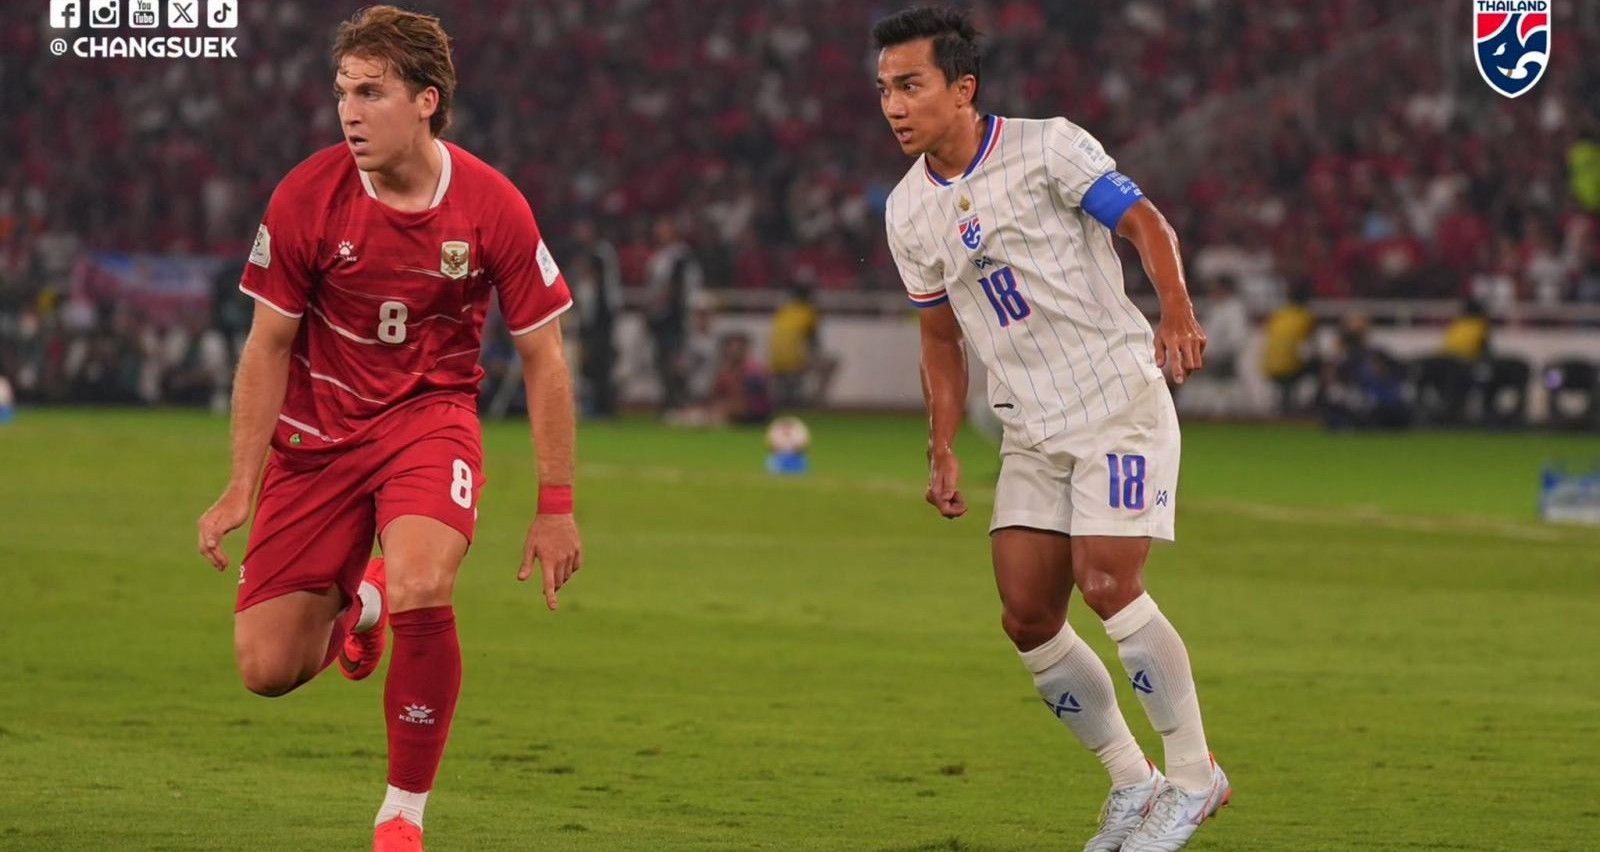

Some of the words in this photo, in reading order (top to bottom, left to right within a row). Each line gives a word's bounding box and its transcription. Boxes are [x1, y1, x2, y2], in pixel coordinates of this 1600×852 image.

[378, 301, 408, 344] 8
[977, 266, 1032, 328] 18
[450, 458, 472, 509] 8
[1106, 453, 1146, 510] 18
[398, 714, 435, 725] KELME
